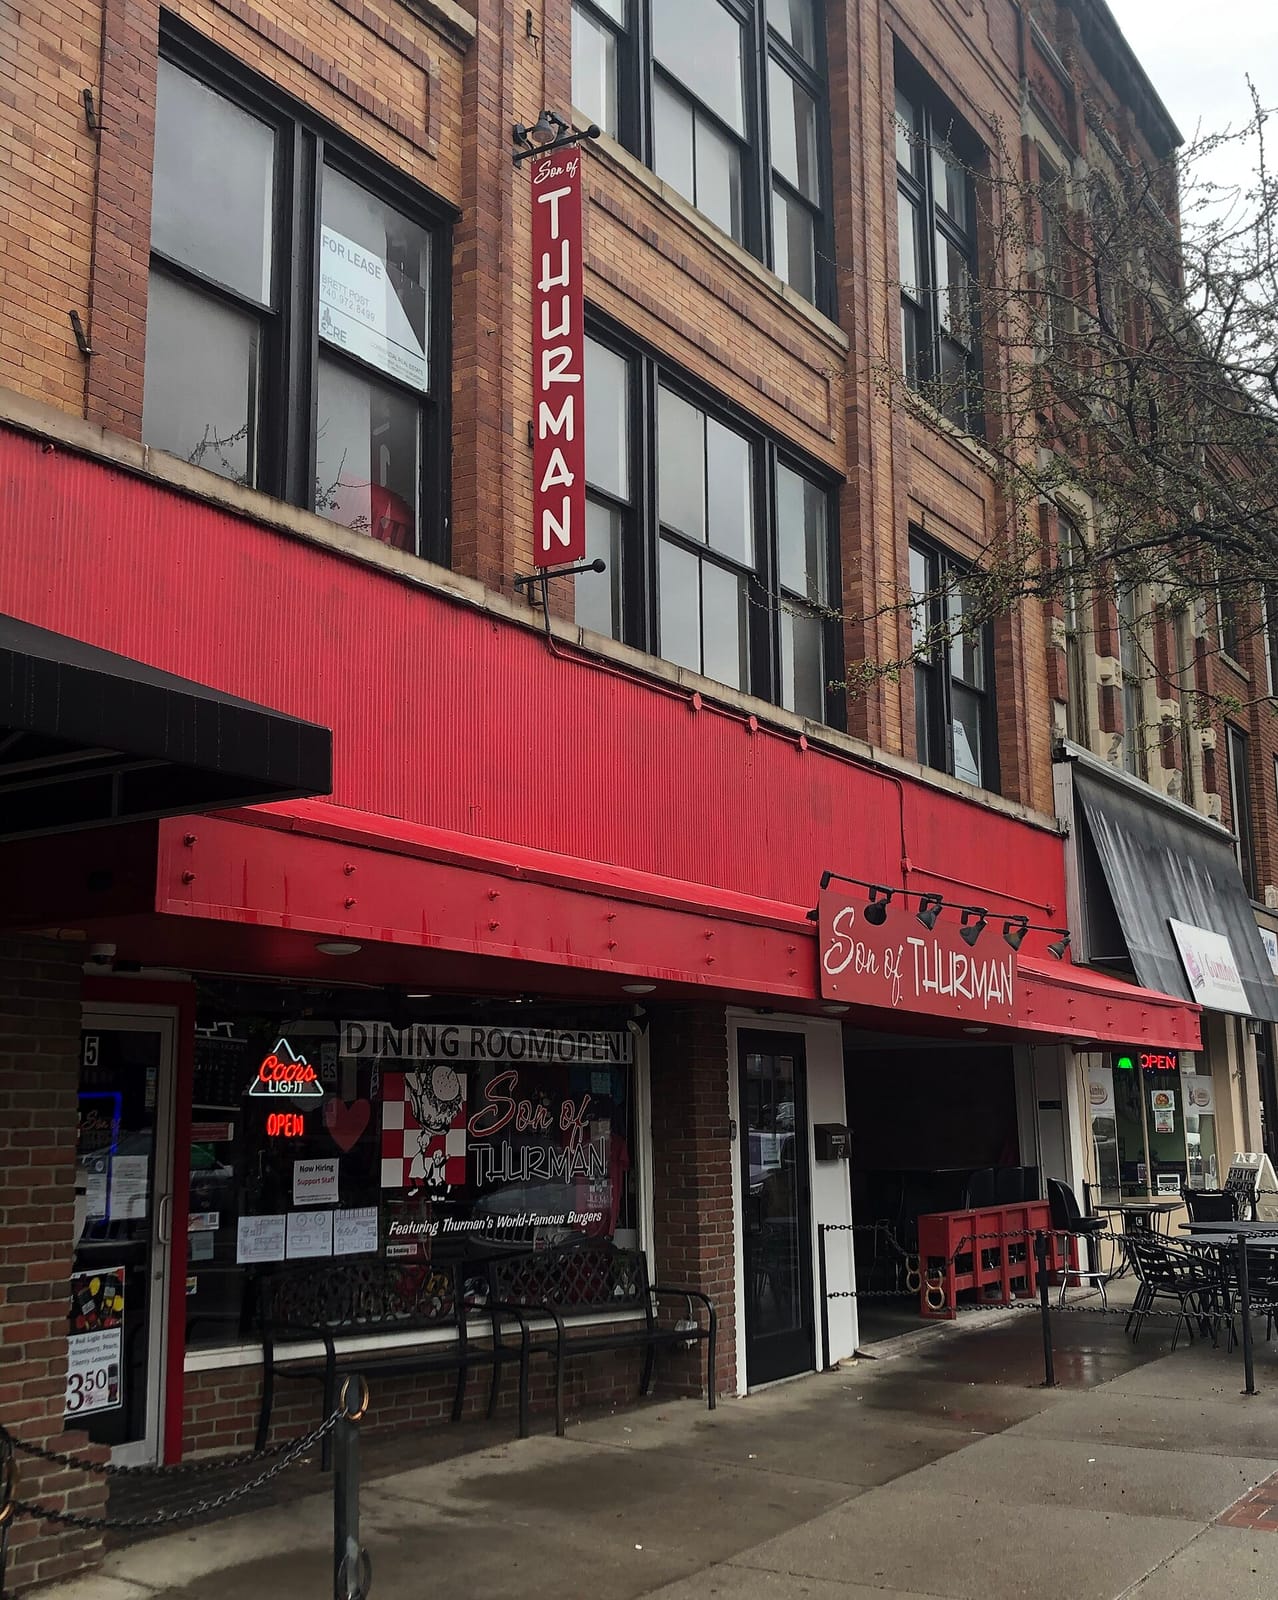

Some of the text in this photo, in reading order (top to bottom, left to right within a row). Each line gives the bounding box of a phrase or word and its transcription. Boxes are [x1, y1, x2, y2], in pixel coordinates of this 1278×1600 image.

[533, 157, 579, 185] Son of
[321, 235, 382, 280] FOR LEASE
[321, 273, 370, 307] BRETT POST
[537, 186, 581, 551] THURMAN
[823, 906, 1014, 1010] Son of THURMAN
[345, 1021, 460, 1057] DINING
[470, 1026, 552, 1061] ROOM
[556, 1030, 629, 1063] OPEN!
[259, 1055, 318, 1082] Coors
[1140, 1053, 1176, 1070] OPEN
[268, 1080, 304, 1093] LIGHT
[266, 1113, 305, 1137] OPEN
[467, 1070, 592, 1154] Son of
[299, 1163, 334, 1174] Now Hiring
[467, 1136, 607, 1186] THURMAN
[297, 1175, 336, 1187] Support Staff
[388, 1210, 603, 1237] Featuring Thurman's World-Famous Burgers
